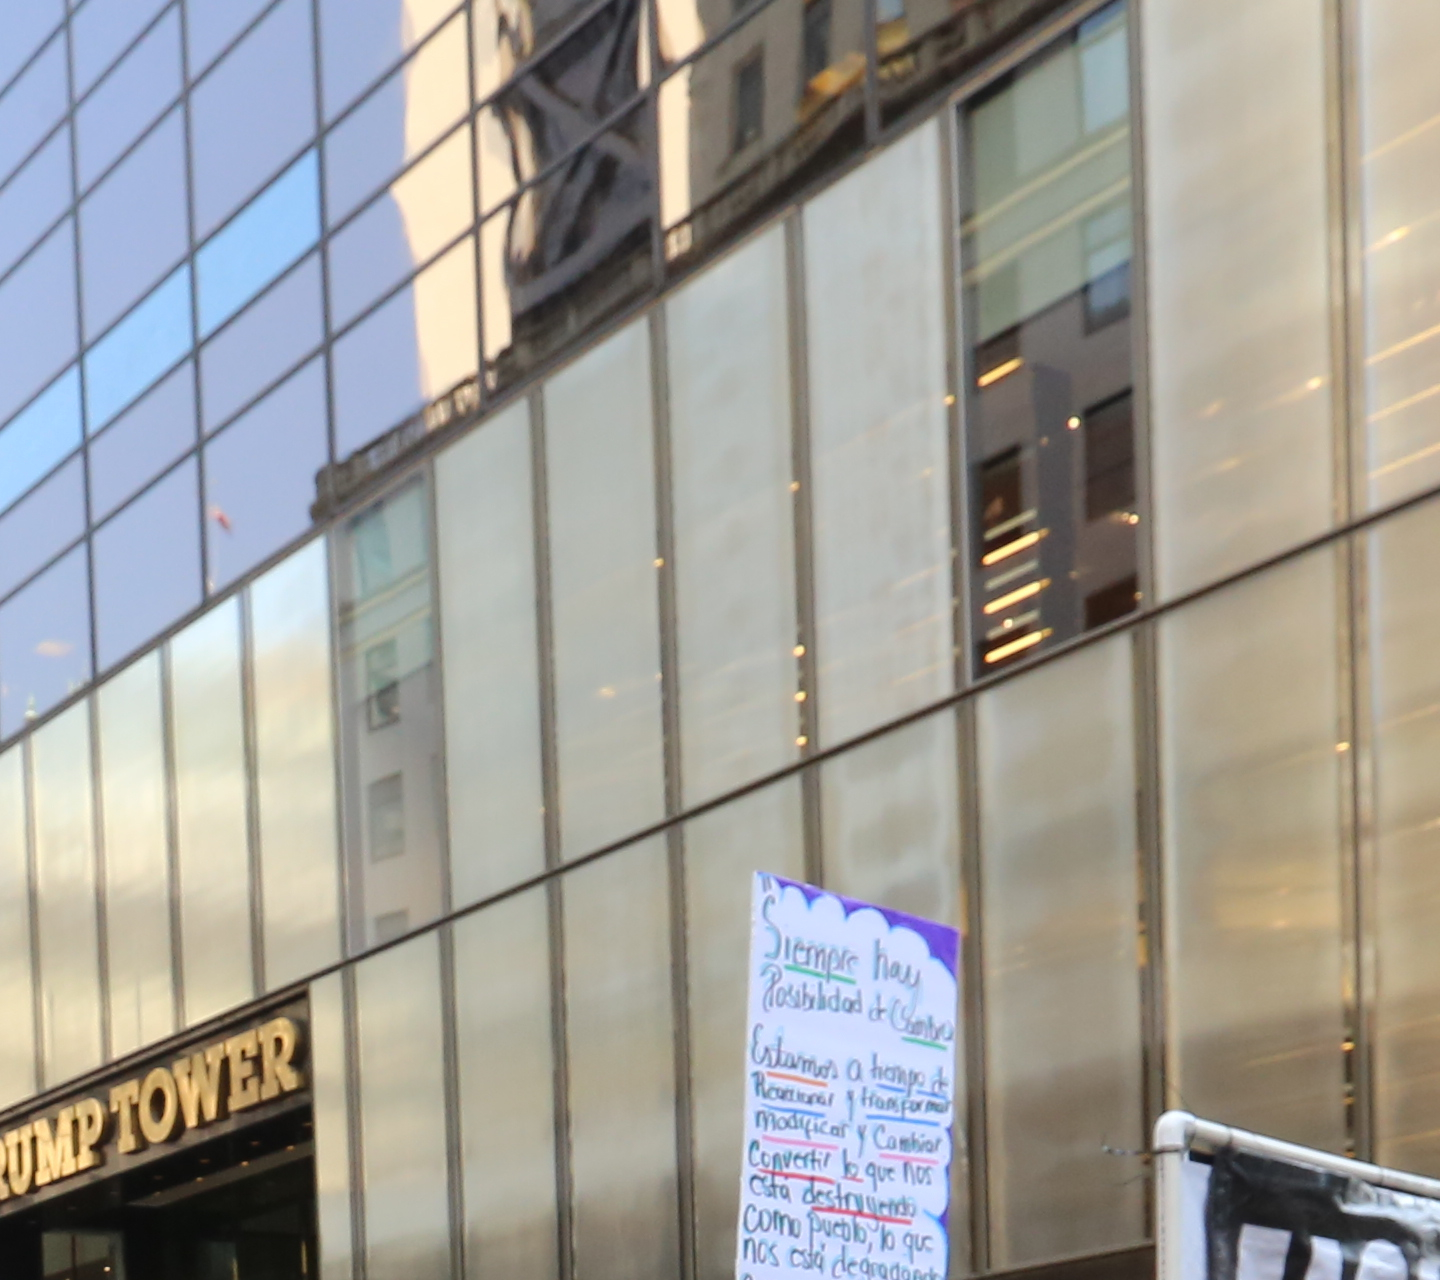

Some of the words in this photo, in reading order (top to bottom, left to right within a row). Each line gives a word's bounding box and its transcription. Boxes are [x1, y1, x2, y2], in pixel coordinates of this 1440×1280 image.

[874, 938, 921, 1022] hay
[109, 1016, 305, 1155] TOWER
[872, 1052, 926, 1098] tiempo
